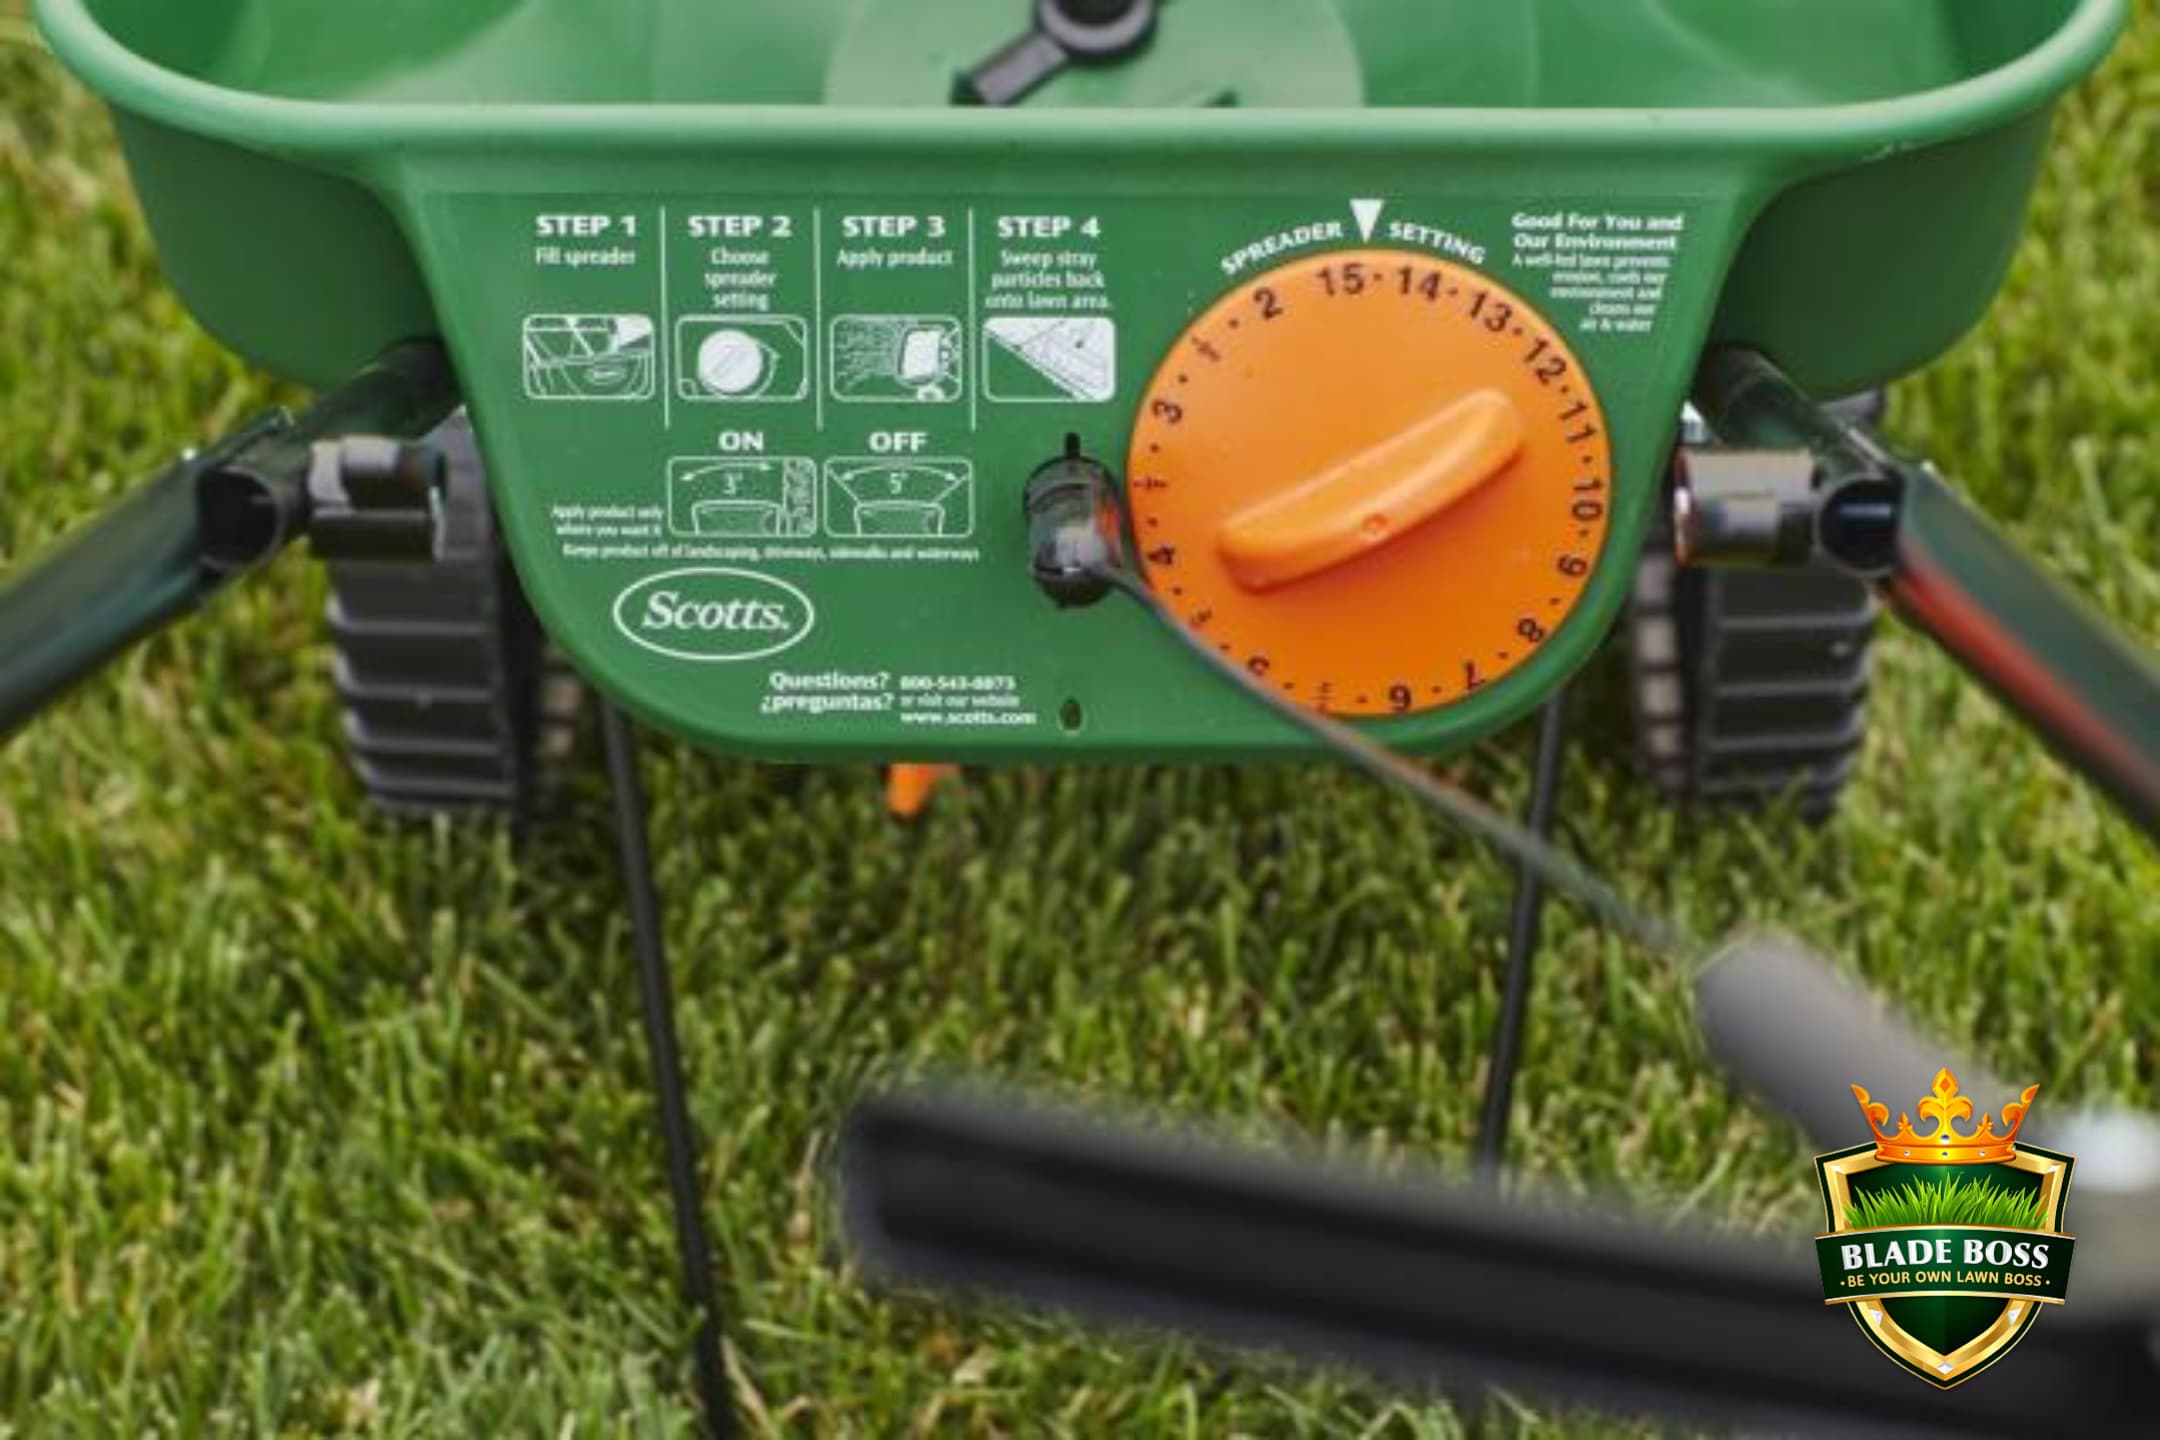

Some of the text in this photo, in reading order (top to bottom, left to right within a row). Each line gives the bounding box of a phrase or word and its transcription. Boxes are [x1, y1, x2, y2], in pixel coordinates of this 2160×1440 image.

[535, 215, 636, 237] STEP 1
[688, 215, 792, 237] STEP 2
[842, 215, 946, 238] STEP 3
[998, 215, 1101, 238] STEP 4
[1512, 213, 1685, 230] Good For You and
[1221, 221, 1486, 275] SPREADER SETTING
[1514, 233, 1677, 249] Our Environment
[535, 248, 636, 267] Fill spreader
[711, 248, 768, 265] Choose
[837, 248, 952, 268] Apply product
[1001, 250, 1097, 269] Sweep stray
[705, 270, 776, 288] spreader
[991, 270, 1104, 290] particles back
[1317, 263, 1365, 296] 15
[1398, 266, 1442, 301] 14
[713, 291, 768, 311] setting
[1253, 287, 1284, 320] 2
[1467, 292, 1512, 332] 13
[1522, 337, 1567, 385] 12
[1152, 400, 1183, 424] 3
[1558, 400, 1597, 442] 11
[718, 431, 764, 452] ON
[868, 431, 926, 452] OFF
[1572, 480, 1603, 521] 10
[1148, 547, 1175, 566] 4
[1557, 555, 1588, 576] 9
[1517, 617, 1545, 643] 8
[769, 671, 890, 691] Questions?
[1464, 662, 1486, 691] 7
[760, 692, 894, 713] ¿preguntas?
[1389, 685, 1412, 713] 6
[900, 711, 1037, 726] www.scotts.com
